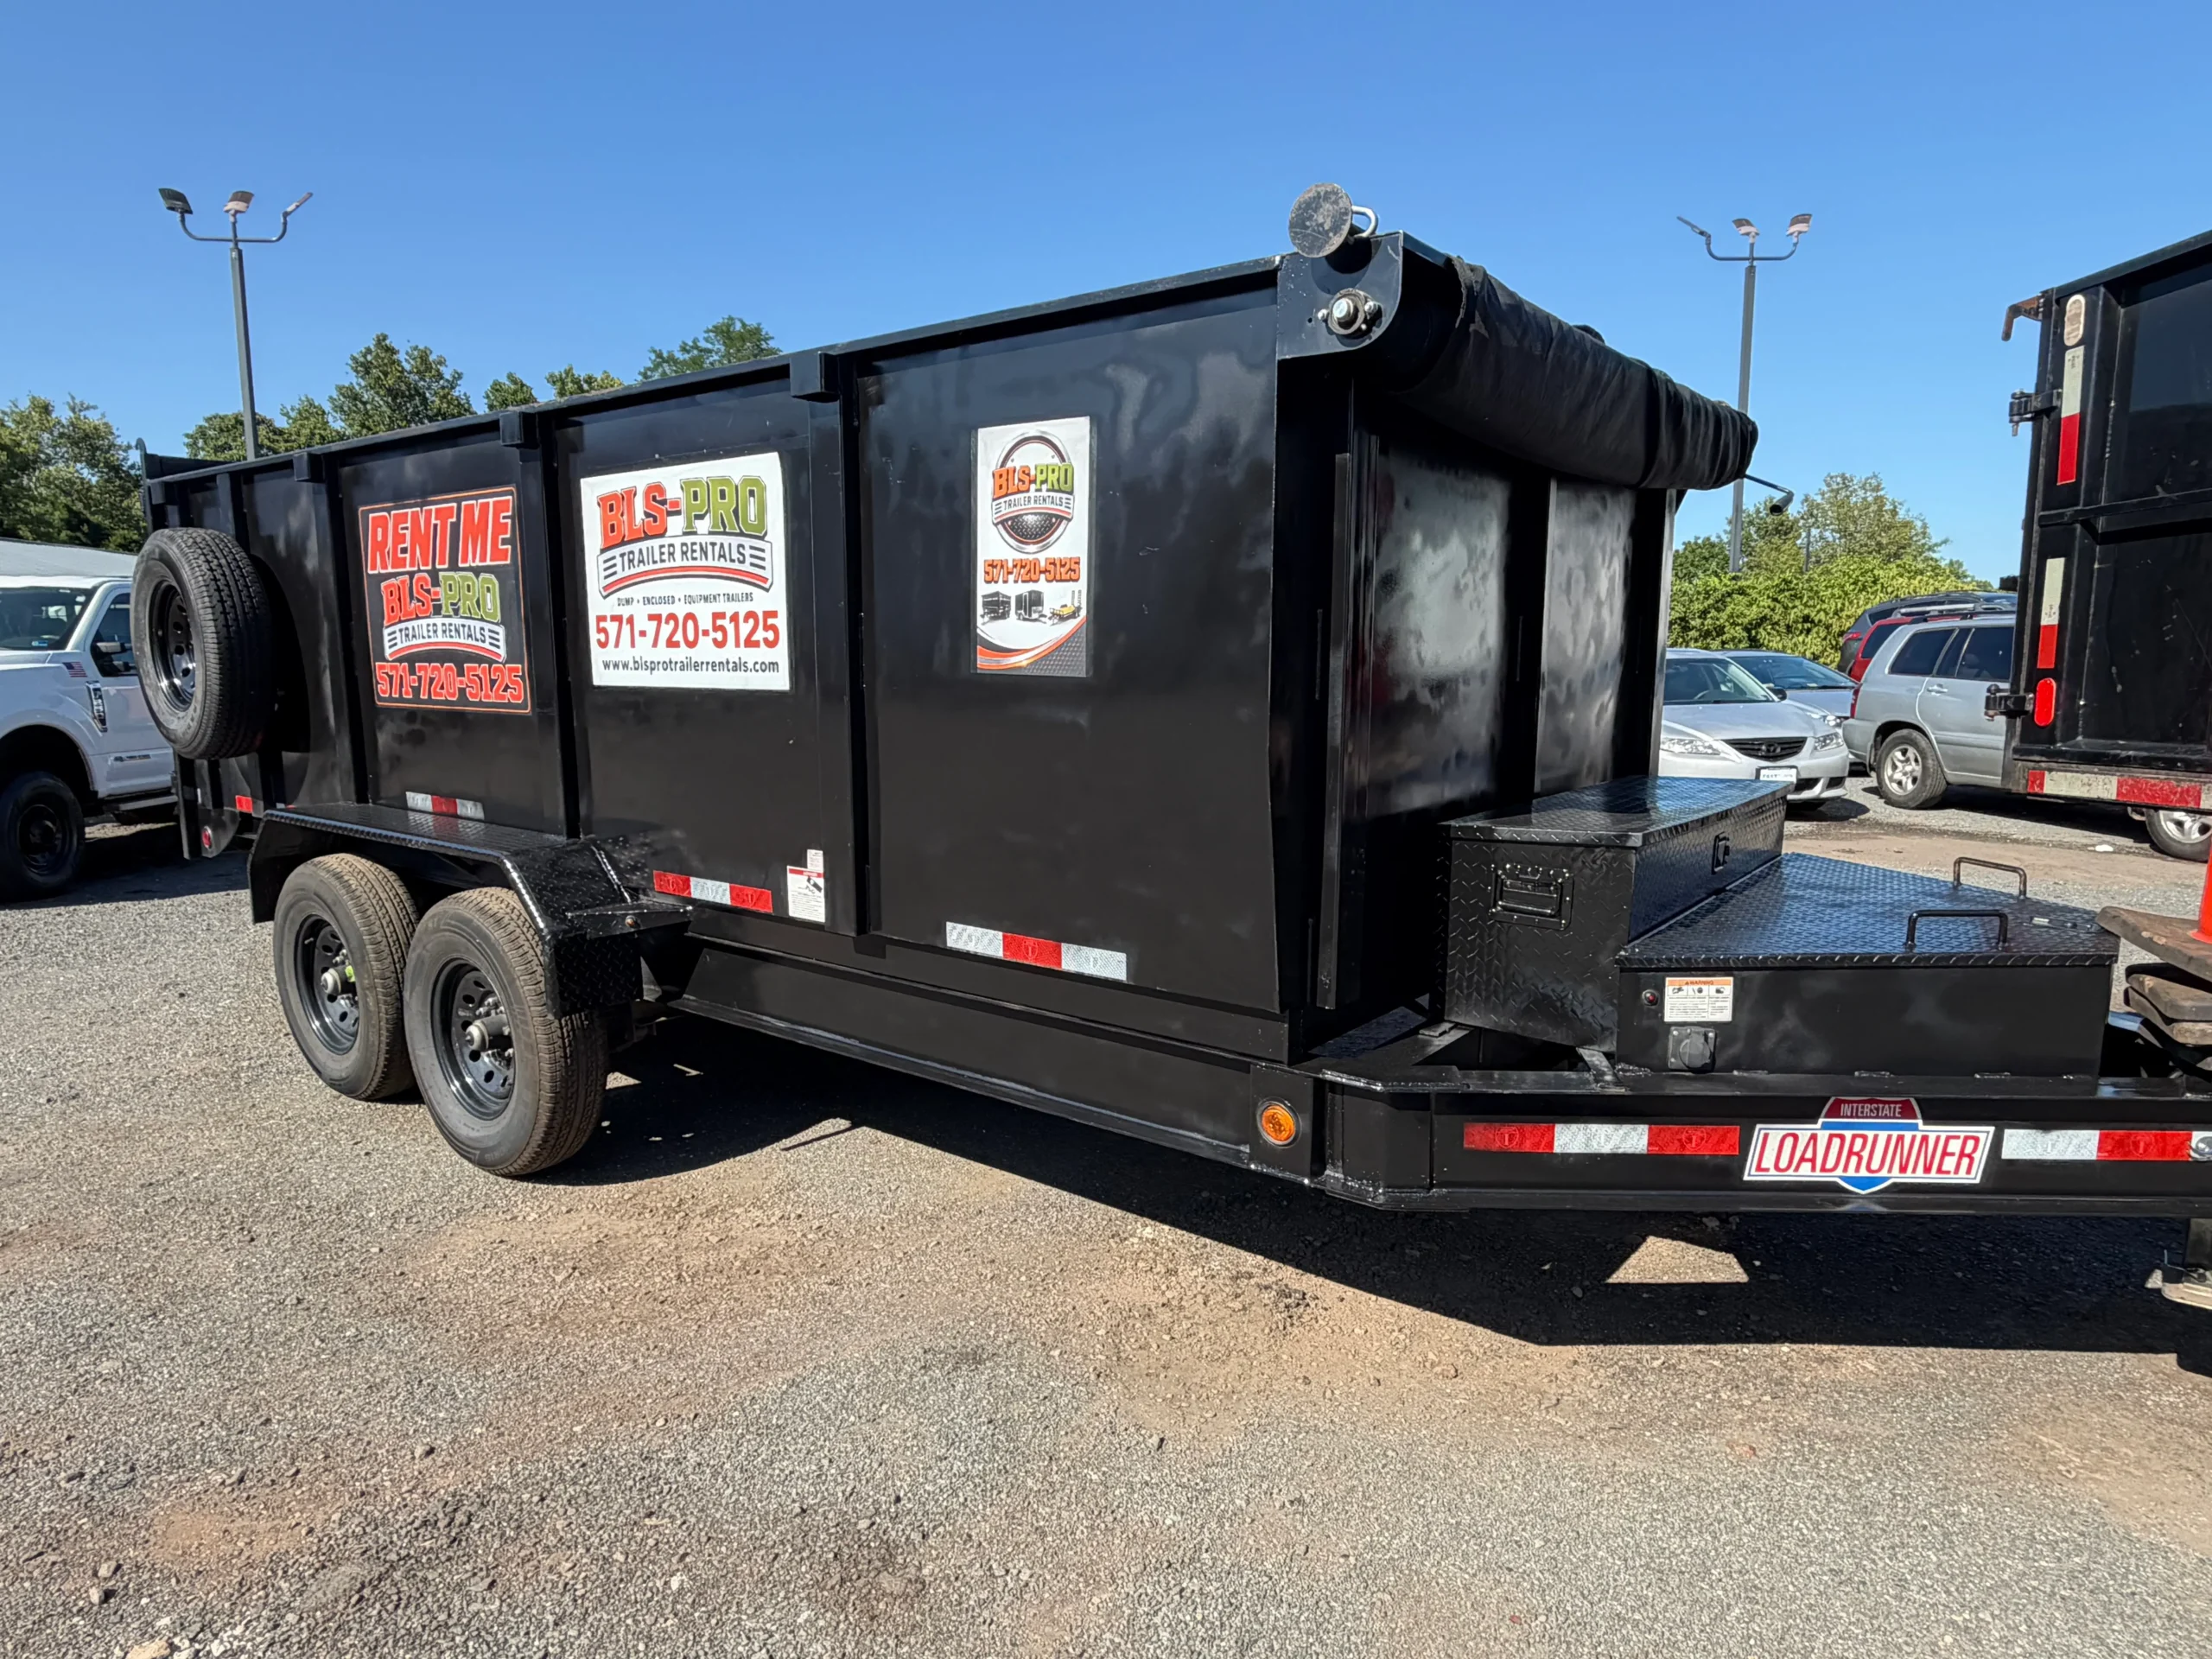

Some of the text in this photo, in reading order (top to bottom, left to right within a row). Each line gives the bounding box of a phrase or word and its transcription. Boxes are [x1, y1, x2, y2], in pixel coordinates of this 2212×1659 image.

[992, 462, 1074, 499] BLS-PRO
[596, 476, 768, 550] BLS-PRO
[1003, 495, 1064, 511] TRAILER RENTALS
[367, 496, 512, 574] RENT ME
[620, 541, 747, 572] TRAILER RENTALS
[983, 556, 1081, 585] 571-720-5125
[380, 571, 502, 626] BLS-PRO
[617, 592, 754, 607] DUMP ENCLOSED EQUIPMENT TRAILERS
[398, 622, 486, 645] TRAILER RENTALS
[595, 610, 780, 649] 571-720-5125
[375, 662, 524, 702] 571-720-5125
[602, 656, 779, 675] www.blsprotrailerrentals.com
[1840, 1103, 1902, 1118] INTERSTATE
[1754, 1132, 1980, 1176] LOADRUNNER
